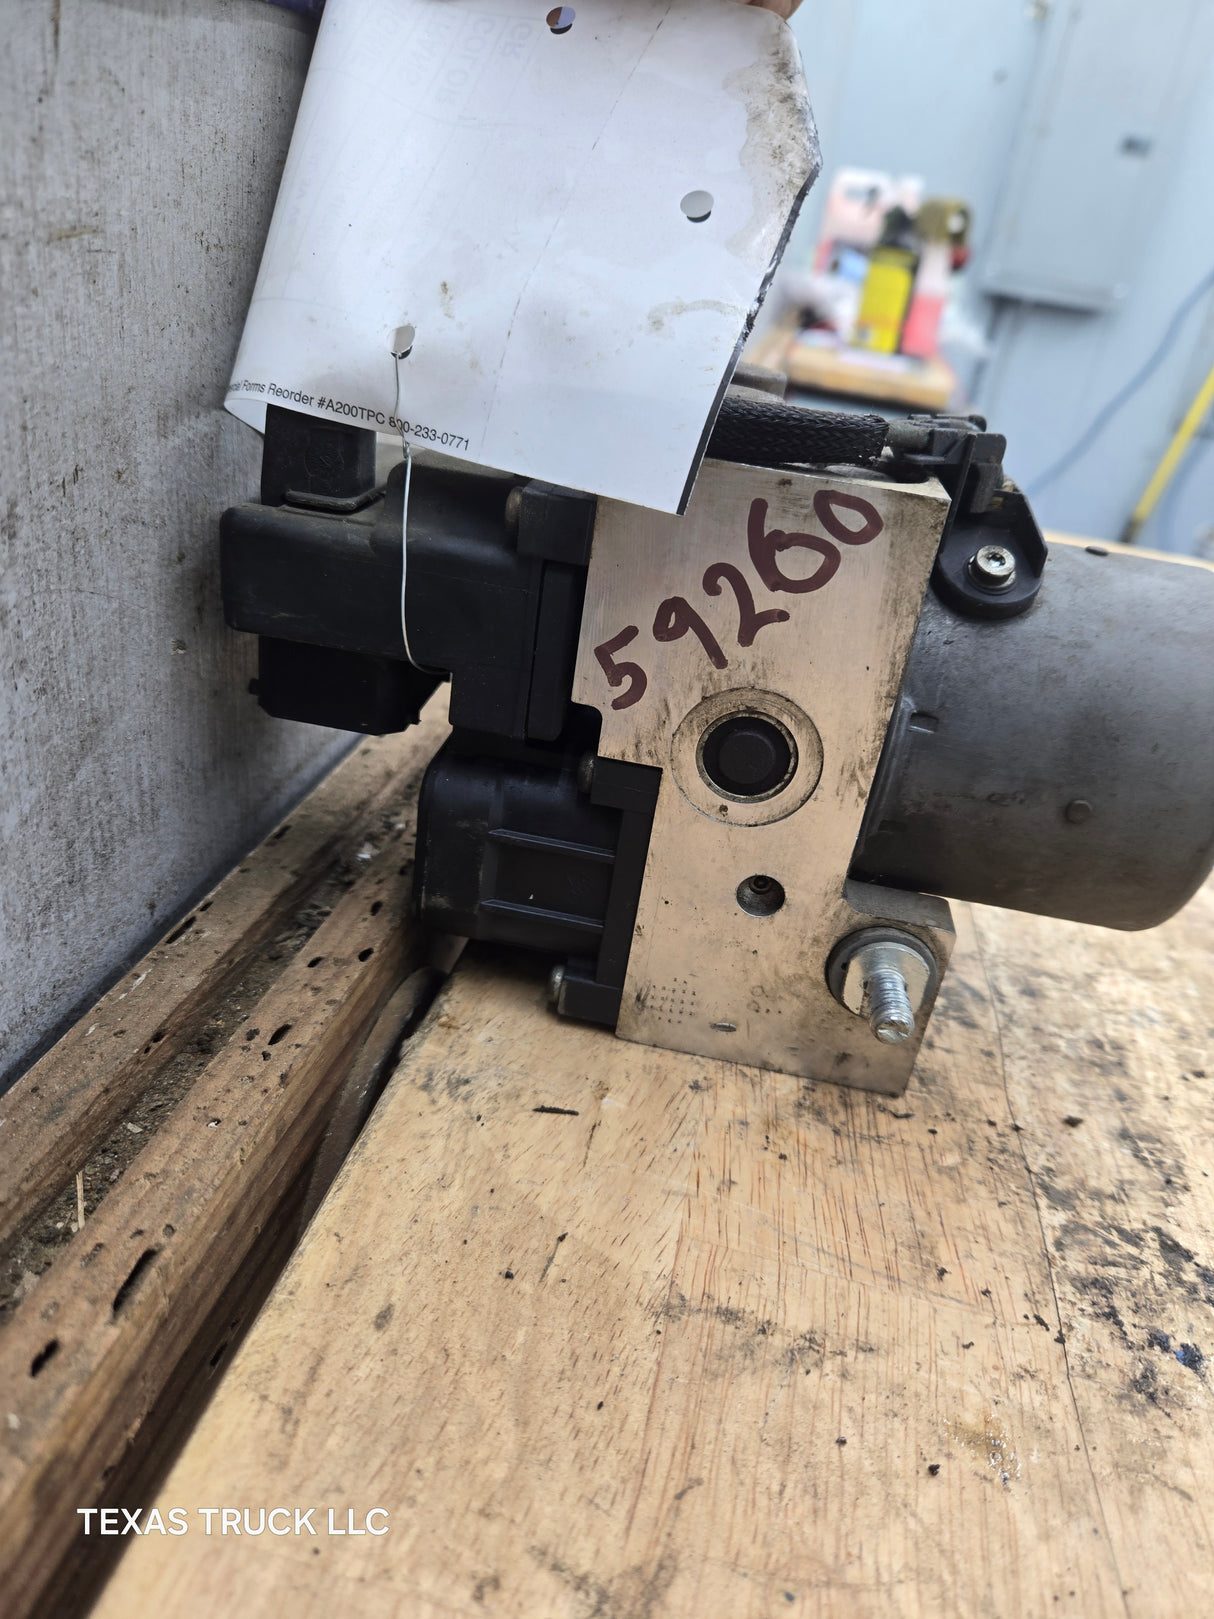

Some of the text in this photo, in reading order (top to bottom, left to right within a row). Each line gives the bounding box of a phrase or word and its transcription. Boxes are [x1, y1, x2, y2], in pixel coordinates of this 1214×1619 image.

[242, 379, 266, 393] Forms
[267, 383, 313, 407] Reorder
[317, 396, 385, 425] #A200TPC
[388, 416, 470, 451] 800-233-0771
[593, 489, 884, 710] 59260
